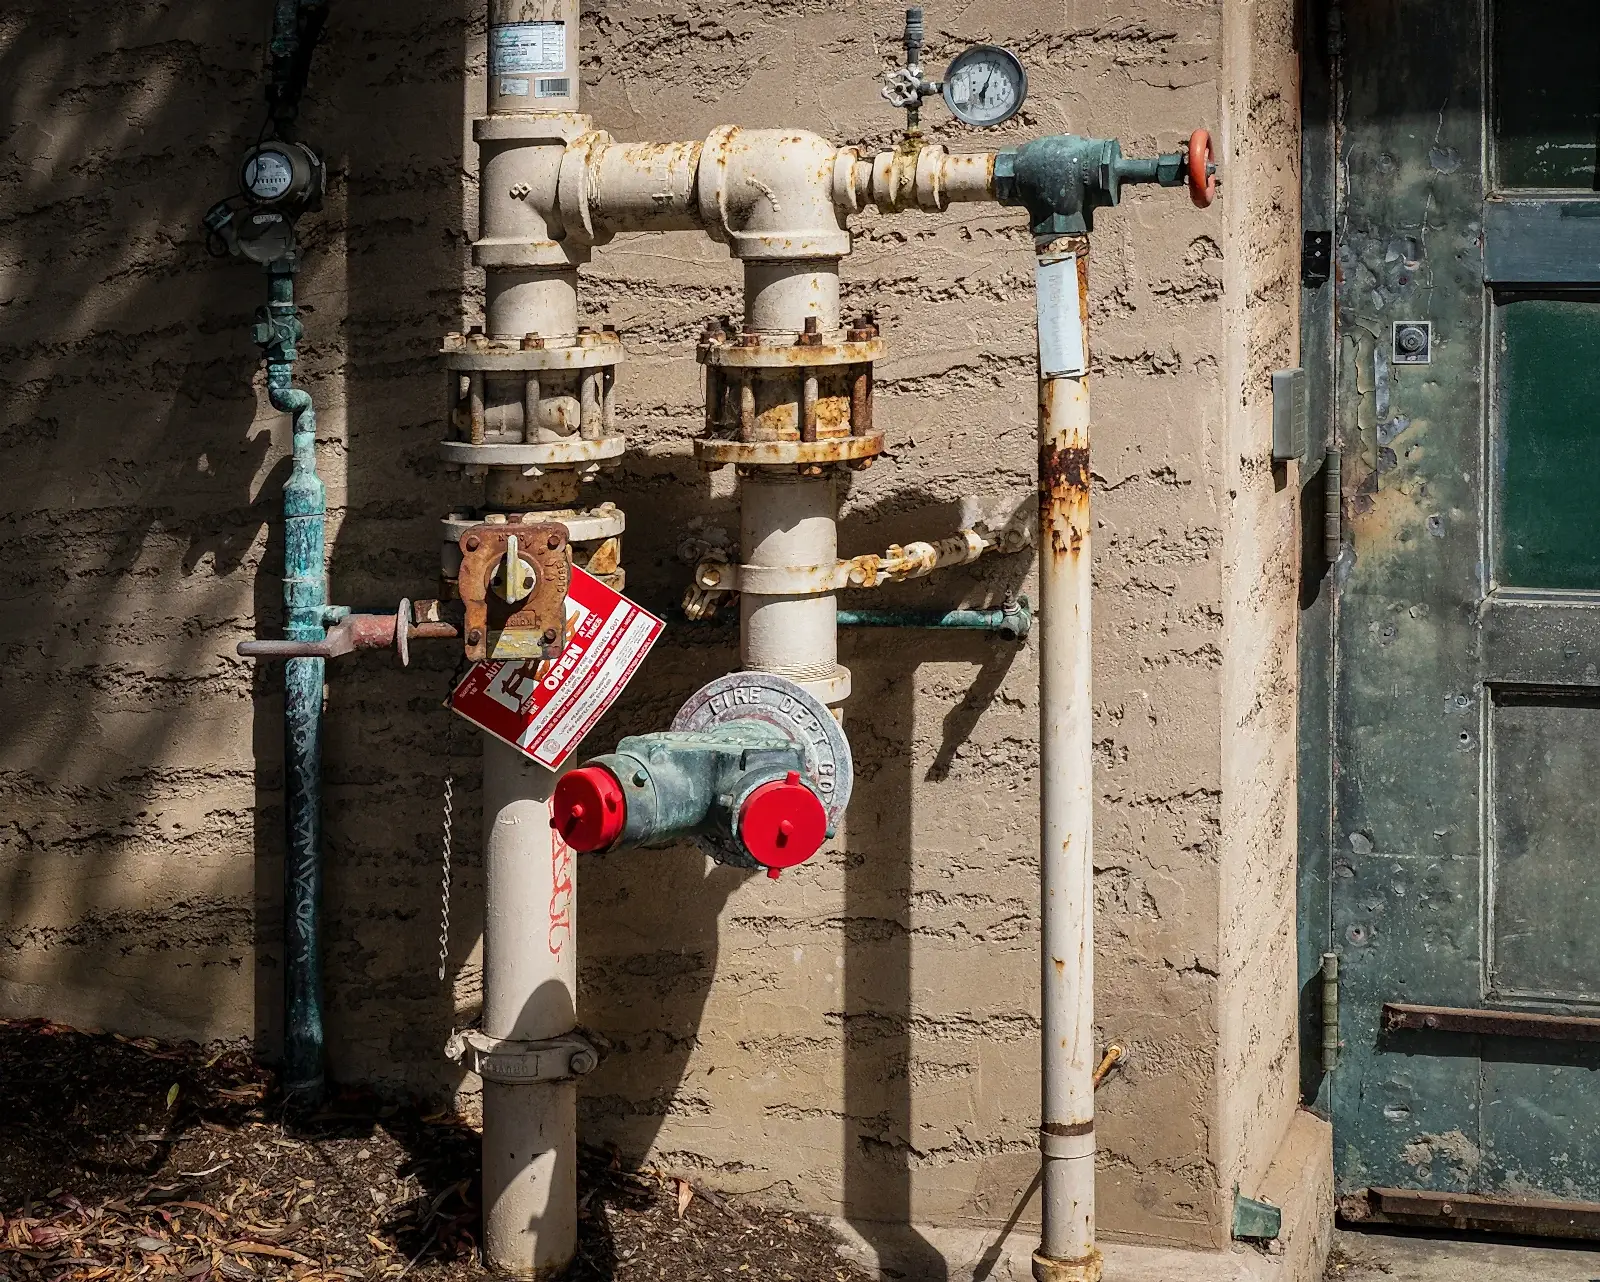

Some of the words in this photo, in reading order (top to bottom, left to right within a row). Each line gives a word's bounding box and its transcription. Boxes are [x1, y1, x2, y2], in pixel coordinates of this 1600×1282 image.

[576, 625, 588, 637] AT
[582, 611, 598, 626] ALL
[608, 618, 620, 630] OUT
[543, 642, 584, 691] OPEN
[708, 687, 762, 716] FIRE
[779, 694, 830, 746] DEPT
